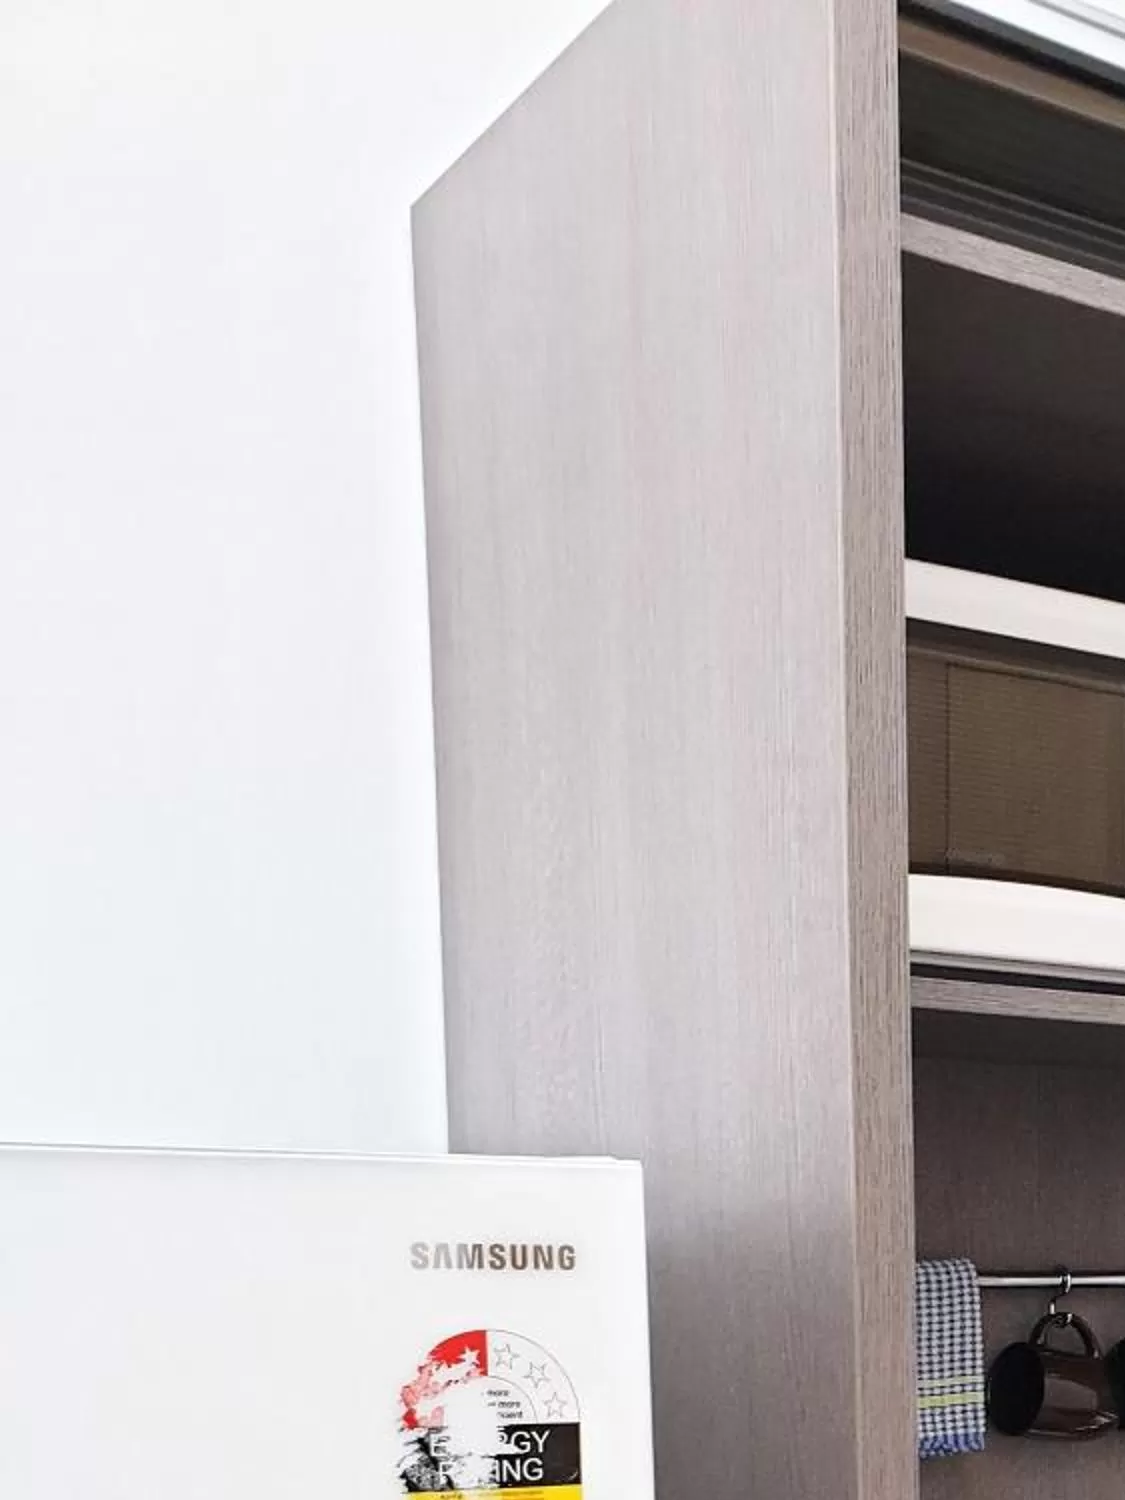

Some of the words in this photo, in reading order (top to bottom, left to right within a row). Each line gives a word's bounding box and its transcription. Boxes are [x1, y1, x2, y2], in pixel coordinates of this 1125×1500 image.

[409, 1241, 577, 1271] SAMSUNG
[429, 1430, 550, 1457] EGY
[438, 1457, 544, 1483] RING
